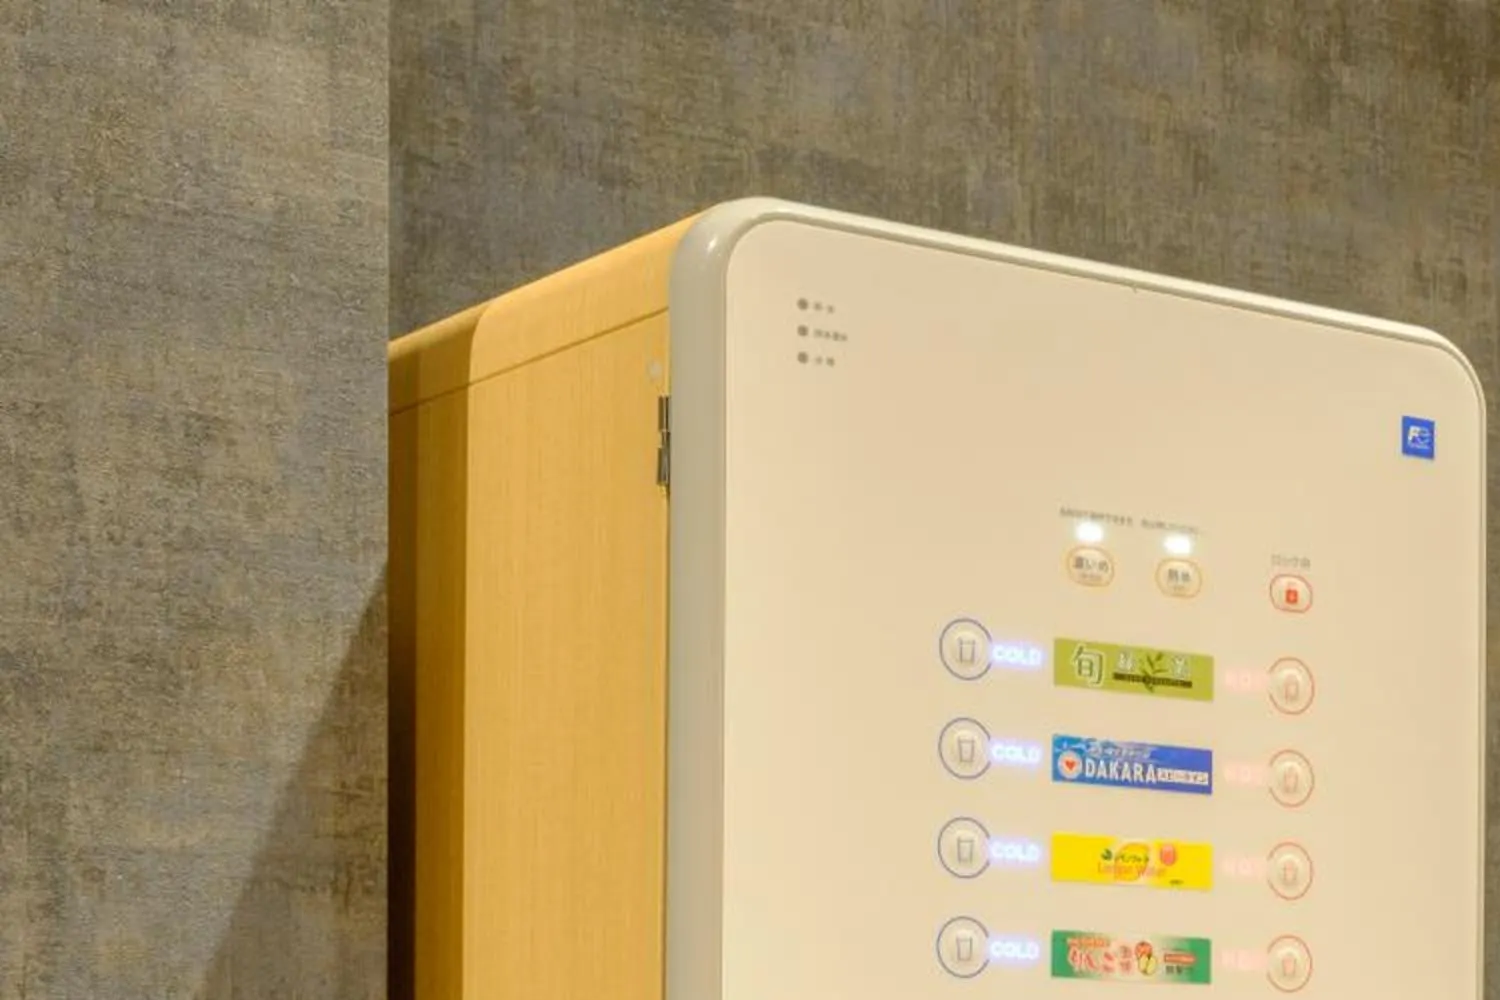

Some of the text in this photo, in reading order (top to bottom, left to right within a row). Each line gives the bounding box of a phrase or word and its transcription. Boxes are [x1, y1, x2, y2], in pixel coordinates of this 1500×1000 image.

[992, 645, 1041, 666] COLD
[991, 744, 1041, 764] COLD
[1085, 757, 1158, 784] DAKARA
[991, 842, 1041, 862] COLD
[990, 940, 1040, 960] COLD
